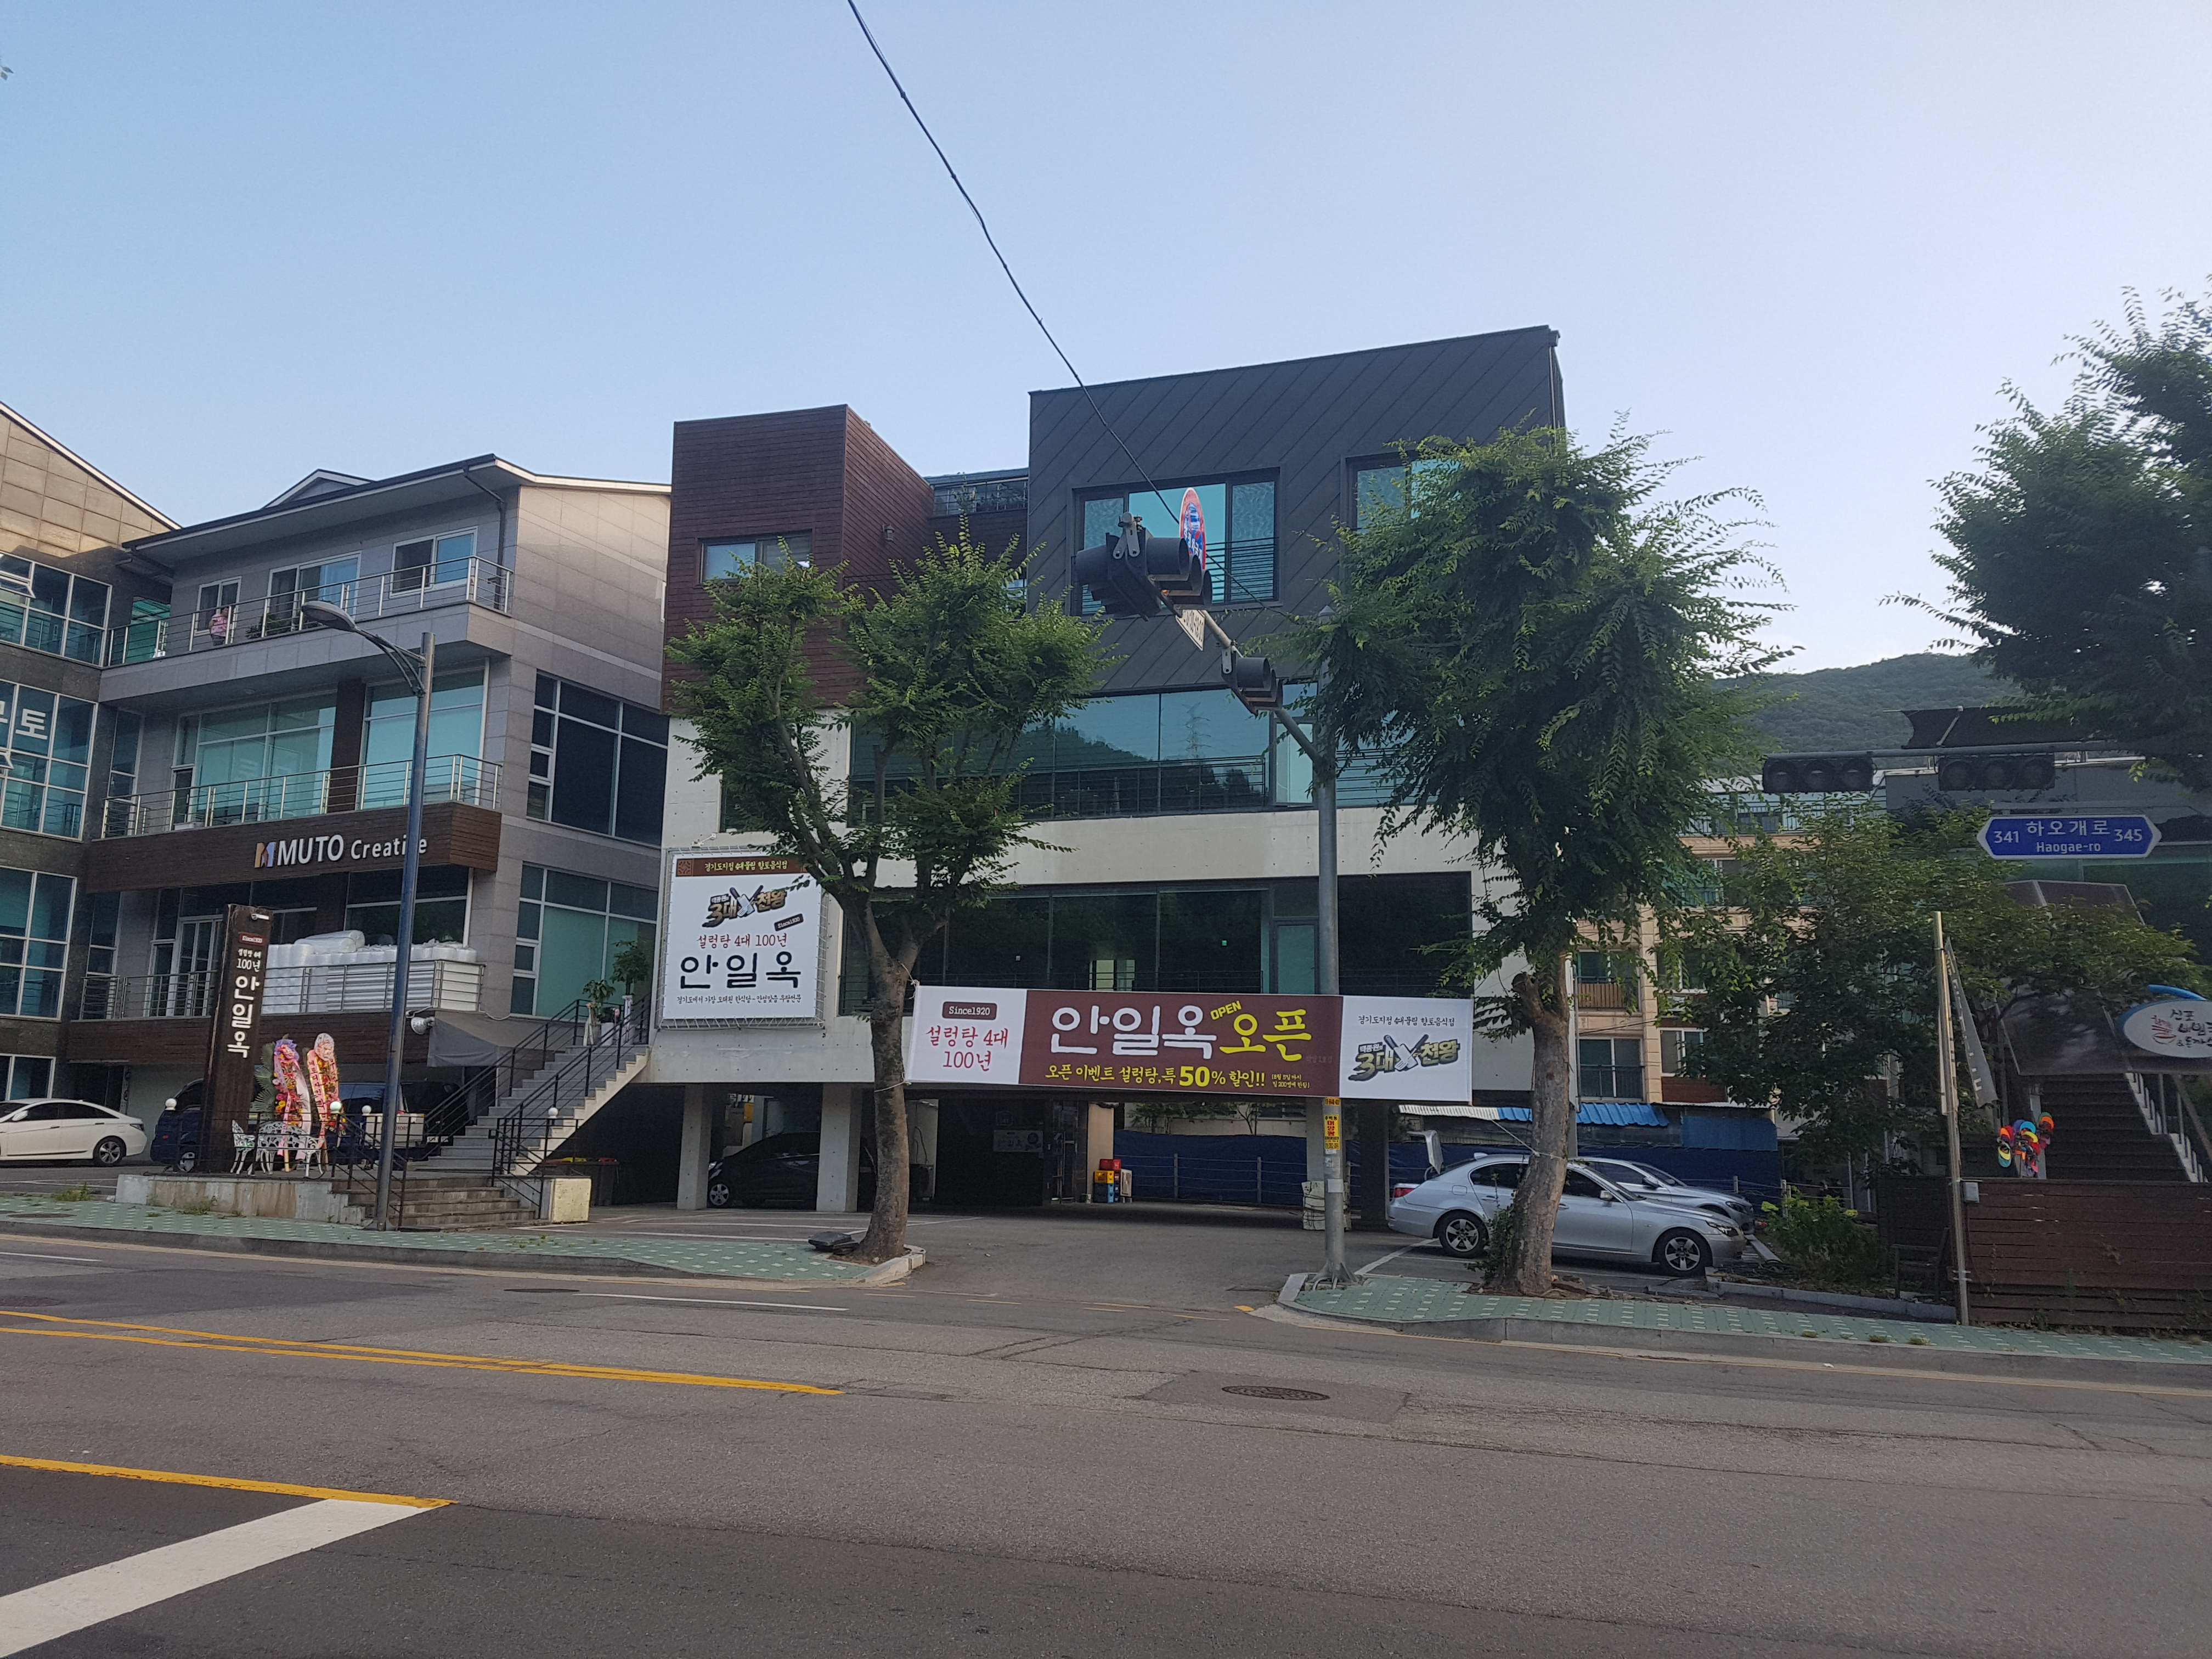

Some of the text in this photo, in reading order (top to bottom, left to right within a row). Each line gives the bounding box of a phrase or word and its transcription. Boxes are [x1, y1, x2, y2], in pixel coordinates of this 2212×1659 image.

[1994, 820, 2142, 843] 341 하오개로 345
[277, 834, 427, 866] MUTO Creatie
[2036, 842, 2101, 854] Haogae-ro
[704, 862, 734, 872] 경기도지정
[758, 860, 787, 871] 향토음식점
[697, 933, 787, 949] 설렁탕 4대 100년
[236, 958, 261, 972] 100년
[680, 951, 801, 989] 안일옥
[676, 995, 703, 1005] 경기도에서
[949, 1006, 990, 1015] Since1920
[1210, 1001, 1242, 1020] OPEN
[227, 976, 259, 1058] 안일옥
[1358, 1015, 1392, 1025] 경기도지정
[1420, 1017, 1455, 1026] 향토음식점
[926, 1025, 1009, 1049] 설렁탕 4대
[1050, 1005, 1312, 1062] 안일옥 오픈
[943, 1050, 991, 1071] 100년
[1348, 1040, 1460, 1081] 3대 천왕
[1045, 1064, 1072, 1080] 오픈
[1076, 1064, 1115, 1081] 이벤트
[1229, 1070, 1265, 1088] 할인!!
